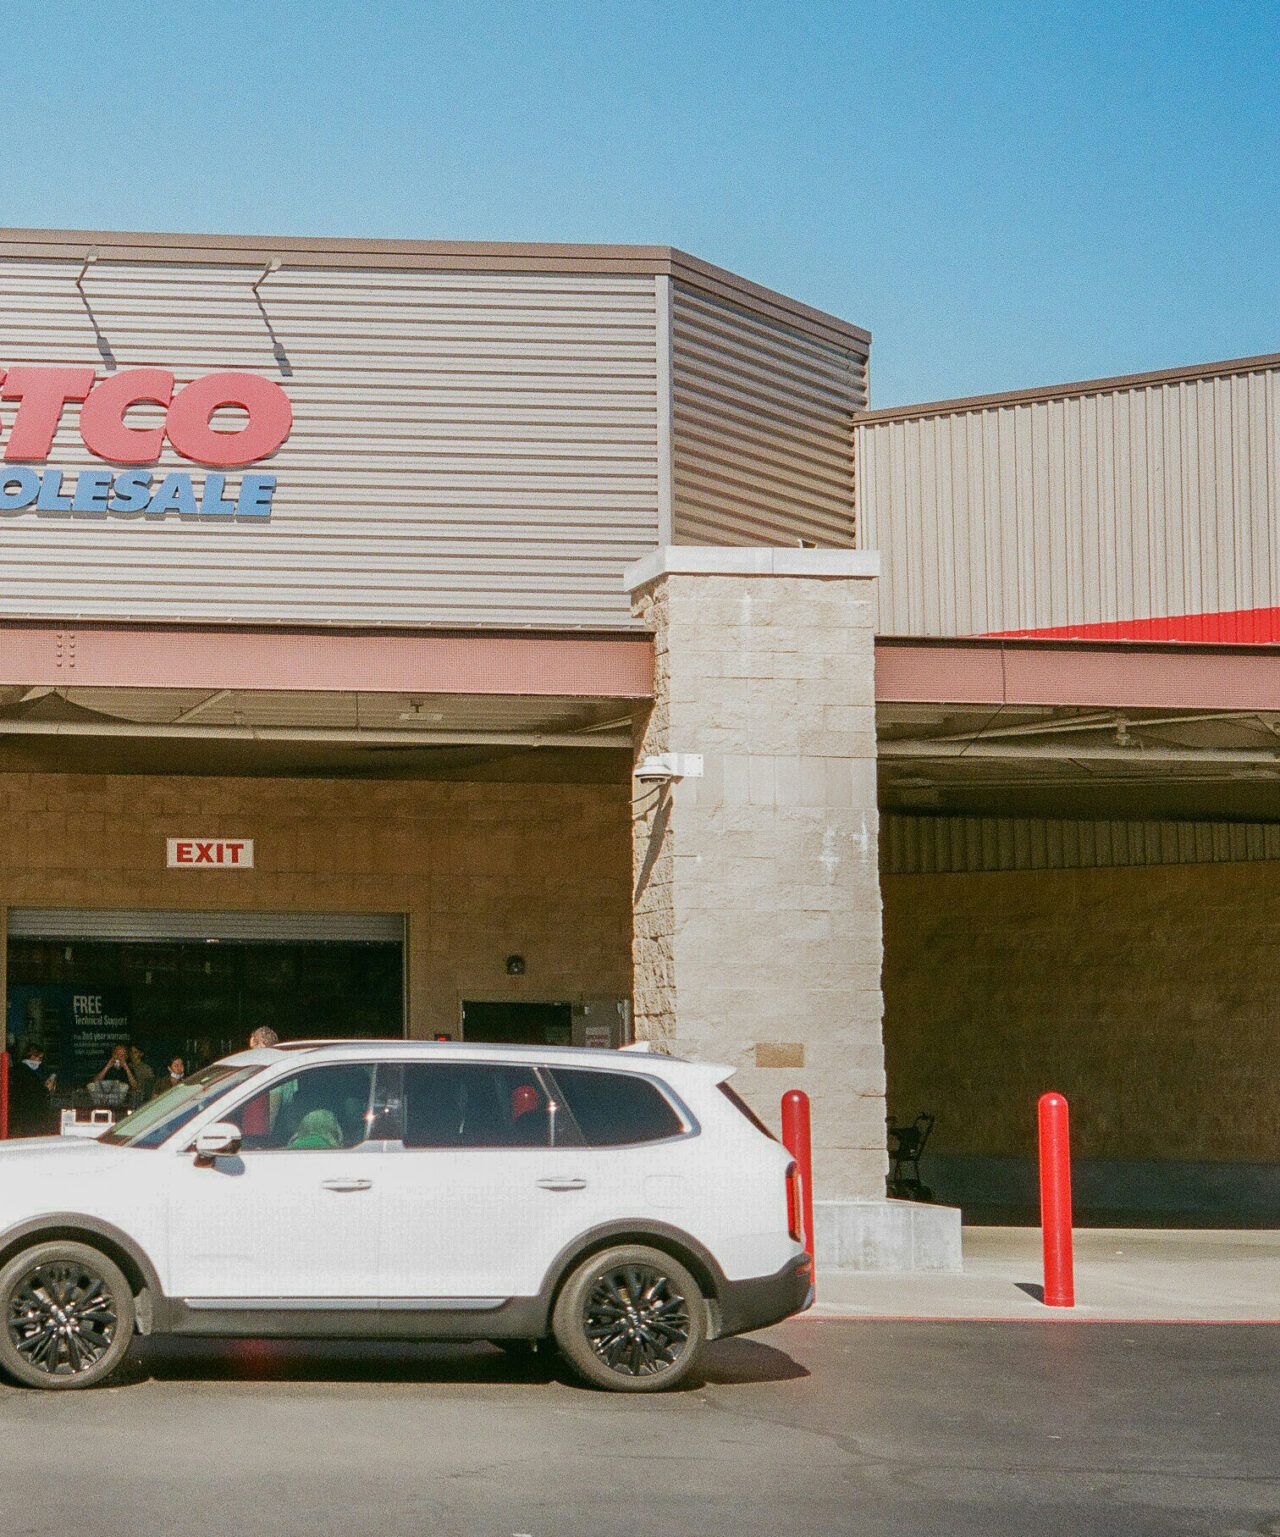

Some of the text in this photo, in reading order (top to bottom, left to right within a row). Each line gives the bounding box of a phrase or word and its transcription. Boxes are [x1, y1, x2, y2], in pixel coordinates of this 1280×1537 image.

[176, 842, 244, 863] EXIT
[73, 995, 102, 1014] FREE
[74, 1014, 128, 1028] Technical Support
